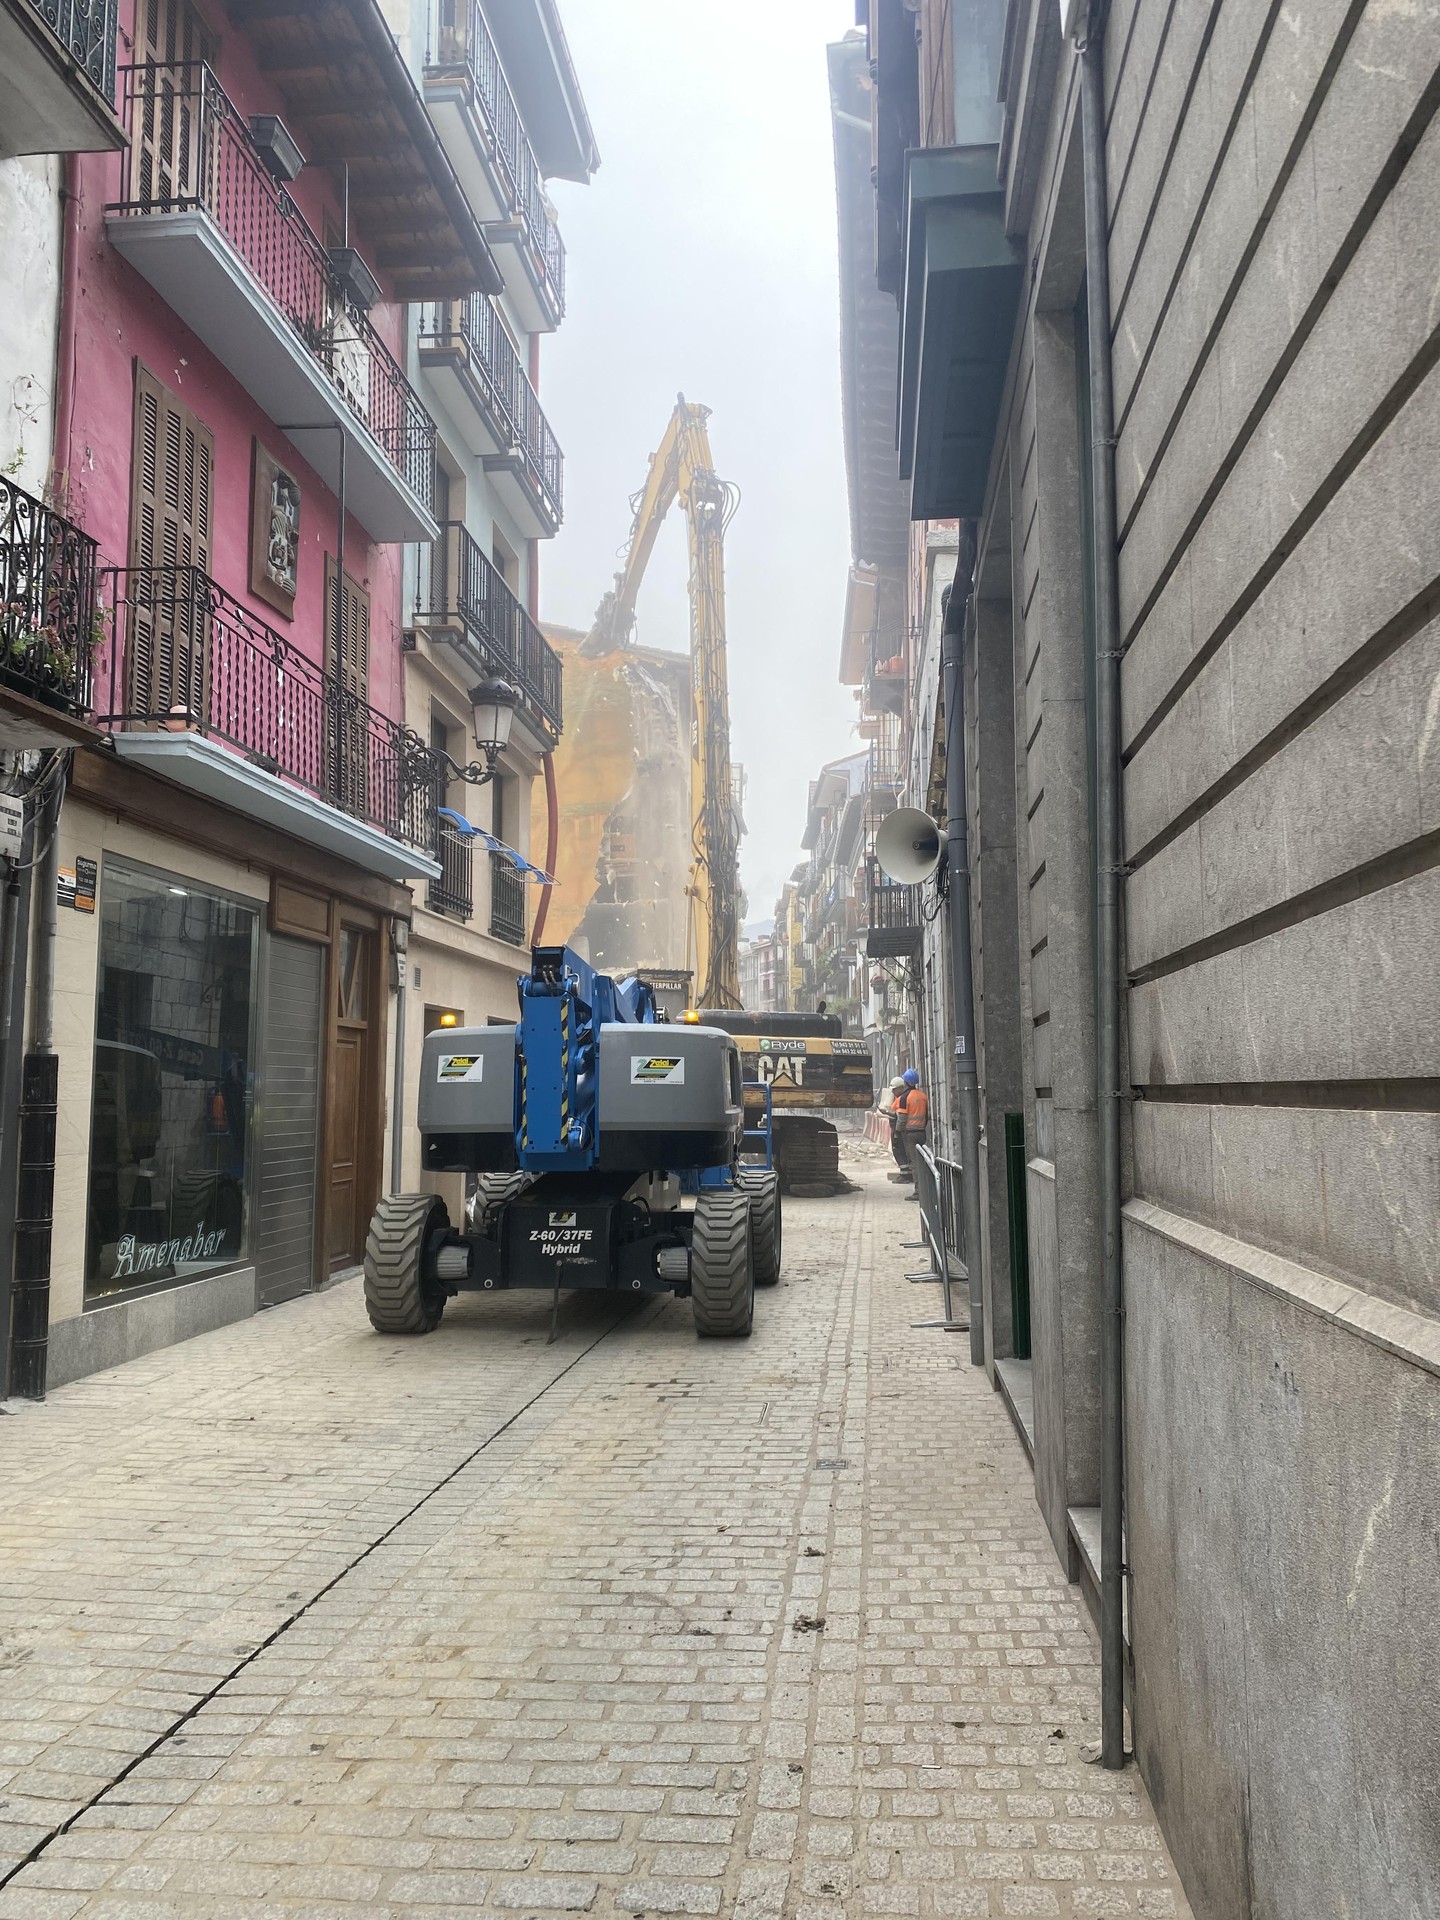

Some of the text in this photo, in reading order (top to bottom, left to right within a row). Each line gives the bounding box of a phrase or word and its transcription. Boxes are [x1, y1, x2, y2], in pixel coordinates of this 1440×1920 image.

[771, 1040, 806, 1051] Ryde
[757, 1055, 807, 1086] CAT
[529, 1229, 593, 1242] Z-60/37FE
[111, 1221, 227, 1279] Amenabar
[541, 1243, 581, 1256] Hybrid
